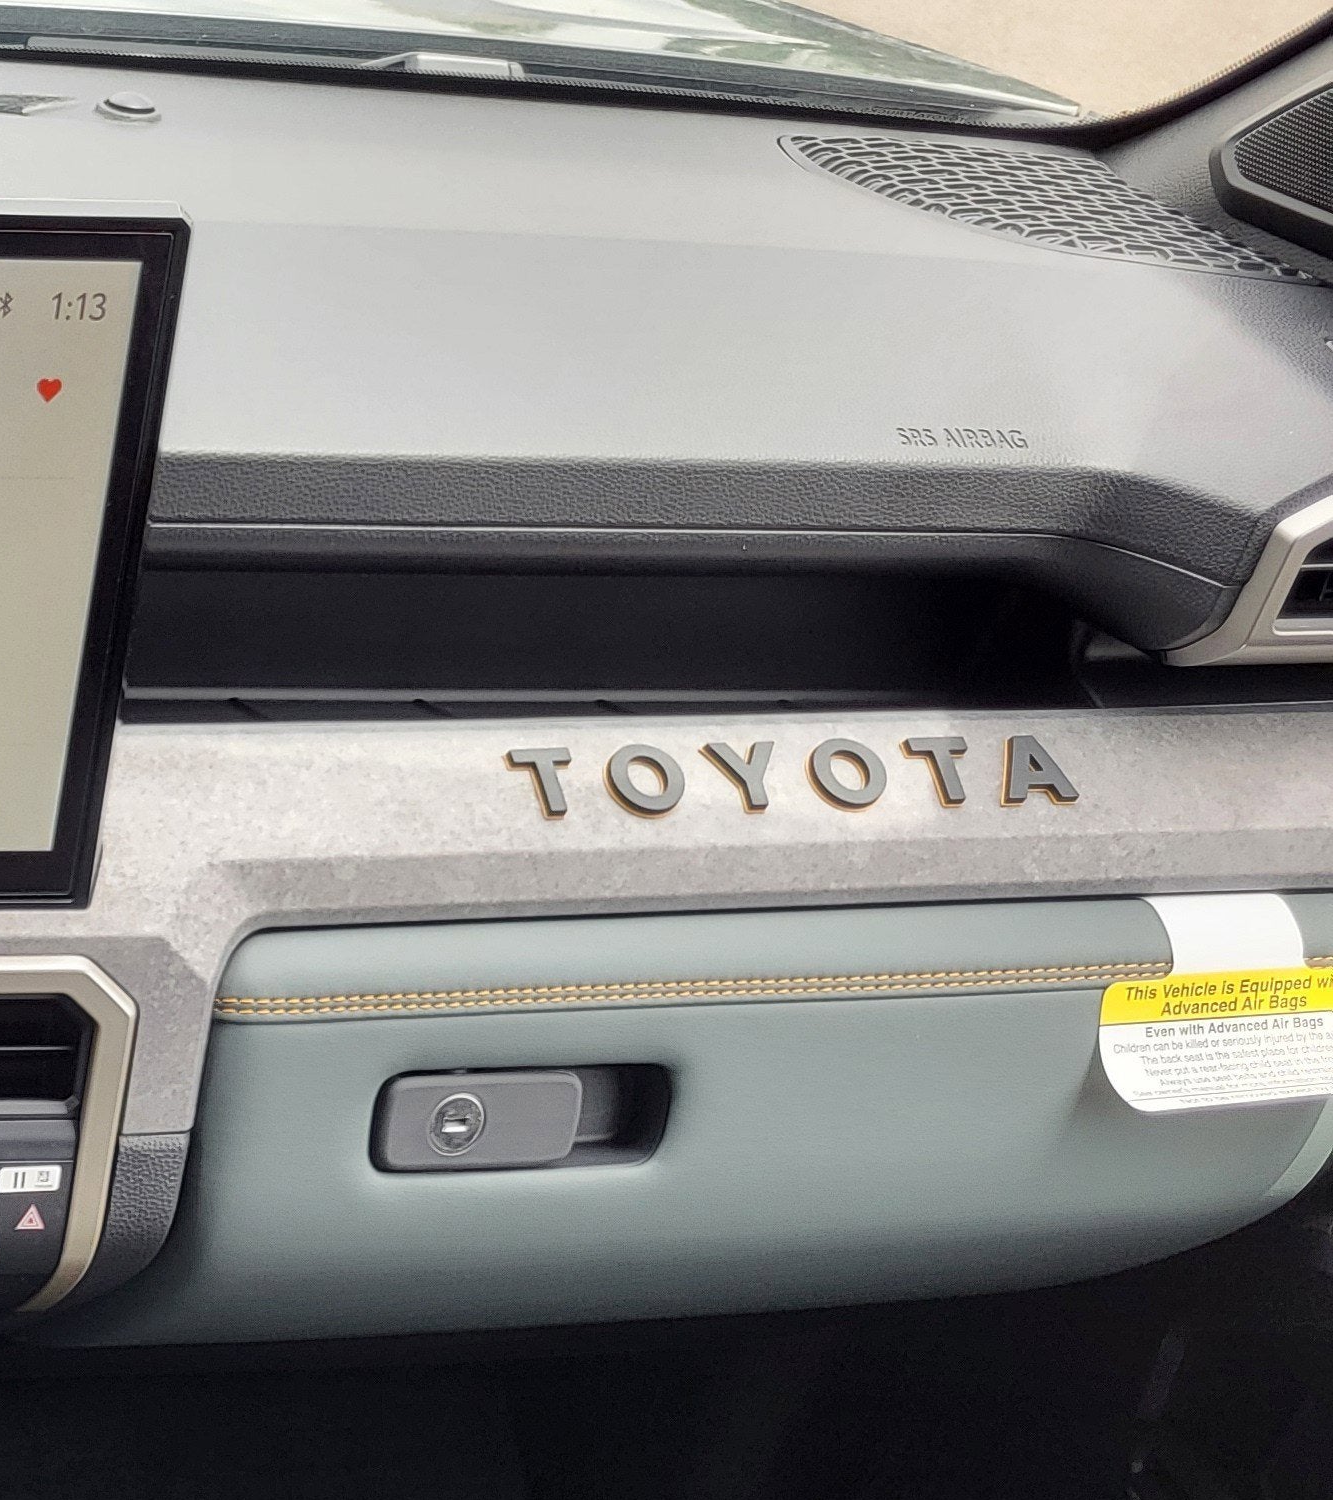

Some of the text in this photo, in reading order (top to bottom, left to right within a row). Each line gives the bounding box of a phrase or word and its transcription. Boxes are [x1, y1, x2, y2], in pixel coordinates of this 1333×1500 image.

[50, 292, 108, 322] 1:13
[896, 427, 1030, 450] SRS AIRBAG
[504, 735, 1080, 820] TOYOTA
[1126, 987, 1157, 1001] This
[1163, 982, 1217, 999] Vehicle
[1222, 981, 1234, 994] is
[1239, 976, 1312, 998] Equipped
[1161, 995, 1307, 1016] Advanced Air Bags
[1145, 1017, 1323, 1038] Even with Advanced Air Bags
[1113, 1043, 1151, 1054] Children
[1153, 1042, 1169, 1051] can
[1172, 1040, 1183, 1050] be
[1186, 1038, 1208, 1049] killed
